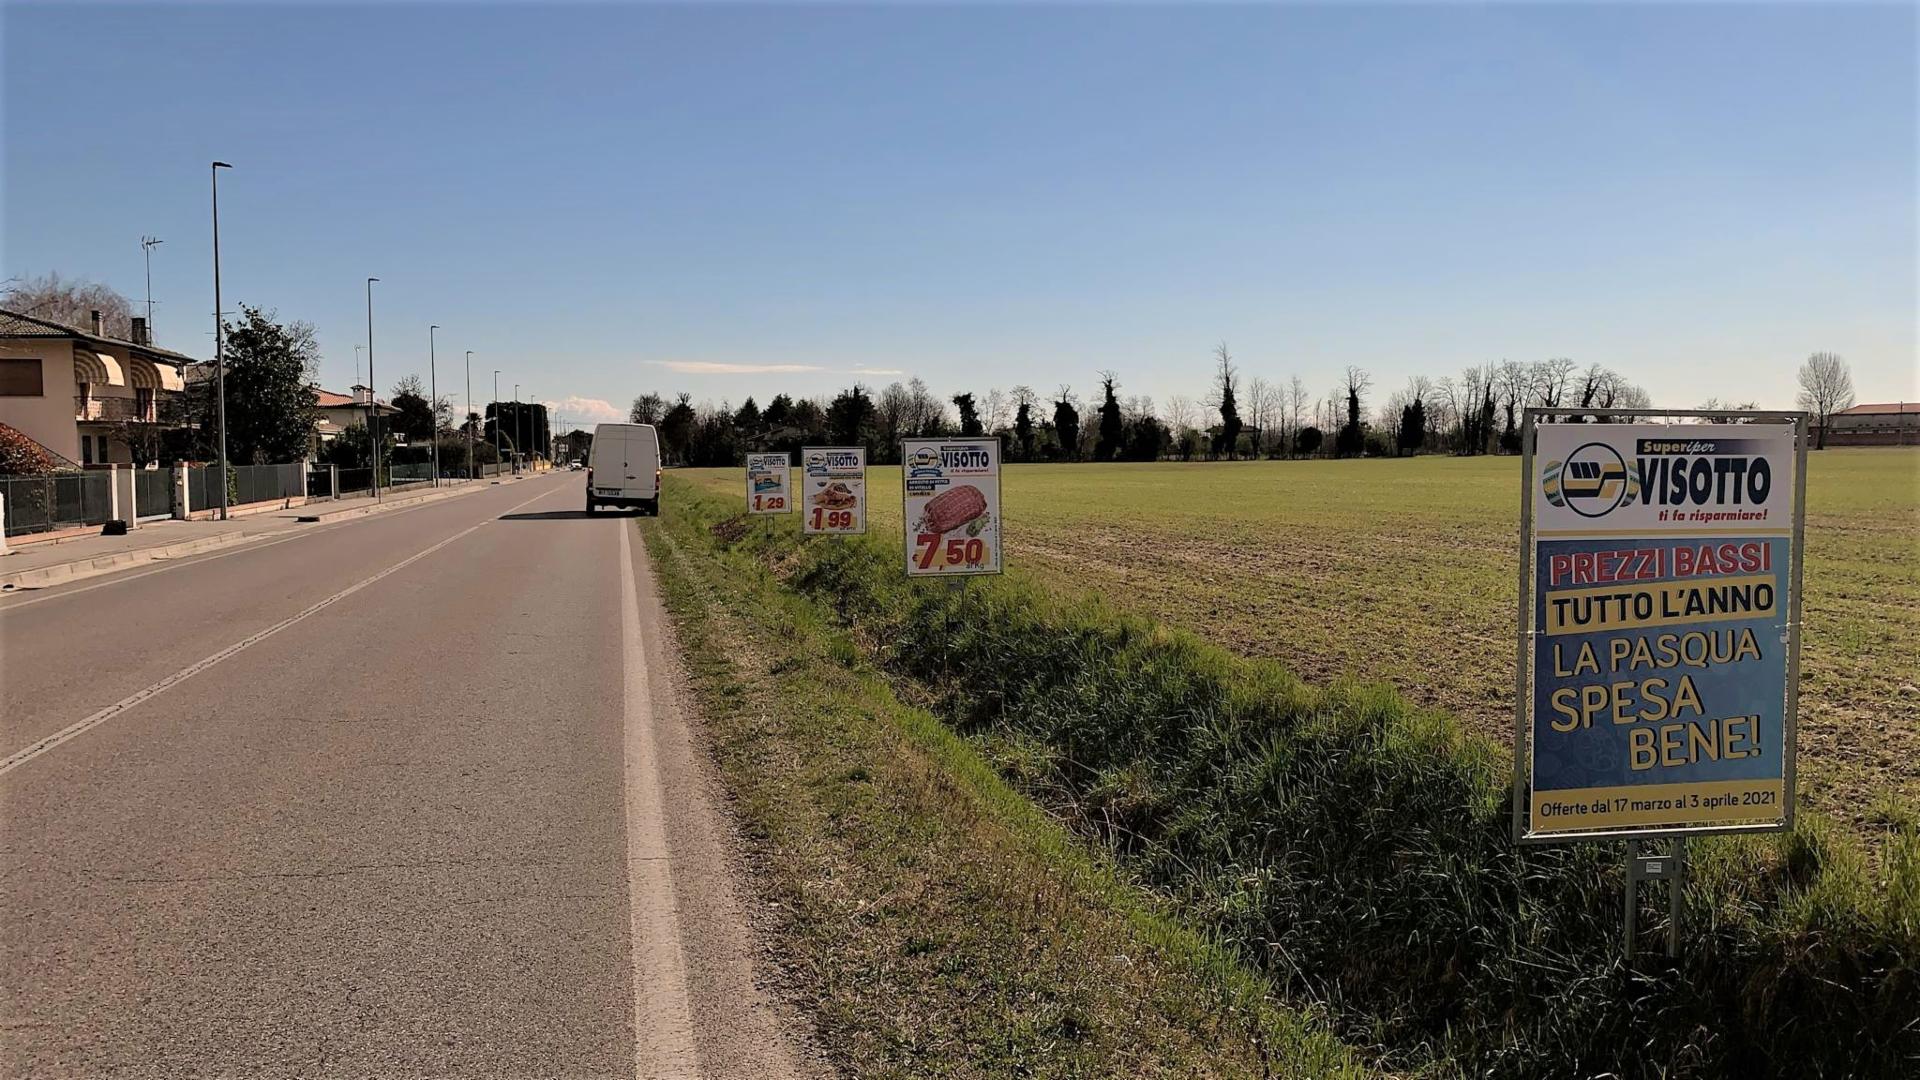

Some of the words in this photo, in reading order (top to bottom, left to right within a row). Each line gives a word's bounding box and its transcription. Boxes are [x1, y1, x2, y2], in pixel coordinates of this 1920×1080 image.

[826, 456, 858, 466] VISOTTO
[941, 451, 989, 467] VISOTTO
[1643, 440, 1716, 453] Superiper
[1637, 457, 1771, 505] VISOTTO
[1658, 509, 1668, 521] ti
[1672, 509, 1685, 521] fa
[1689, 508, 1768, 523] risparmiare!
[1550, 548, 1665, 586] PREZZI
[1672, 542, 1771, 577] BASSI
[1552, 591, 1652, 627] TUTTO
[1660, 583, 1774, 618] L'ANNO
[1554, 641, 1600, 678] LA
[1609, 628, 1763, 673] PASQUA
[1550, 674, 1705, 733] SPESA
[1628, 714, 1762, 772] BENE!
[1540, 802, 1588, 817] Offerte
[1591, 800, 1611, 814] dal
[1614, 798, 1628, 812] 17
[1631, 799, 1672, 811] marzo
[1675, 796, 1687, 809] al
[1690, 795, 1699, 808] 3
[1703, 793, 1739, 810] aprile
[1742, 791, 1776, 805] 2021
